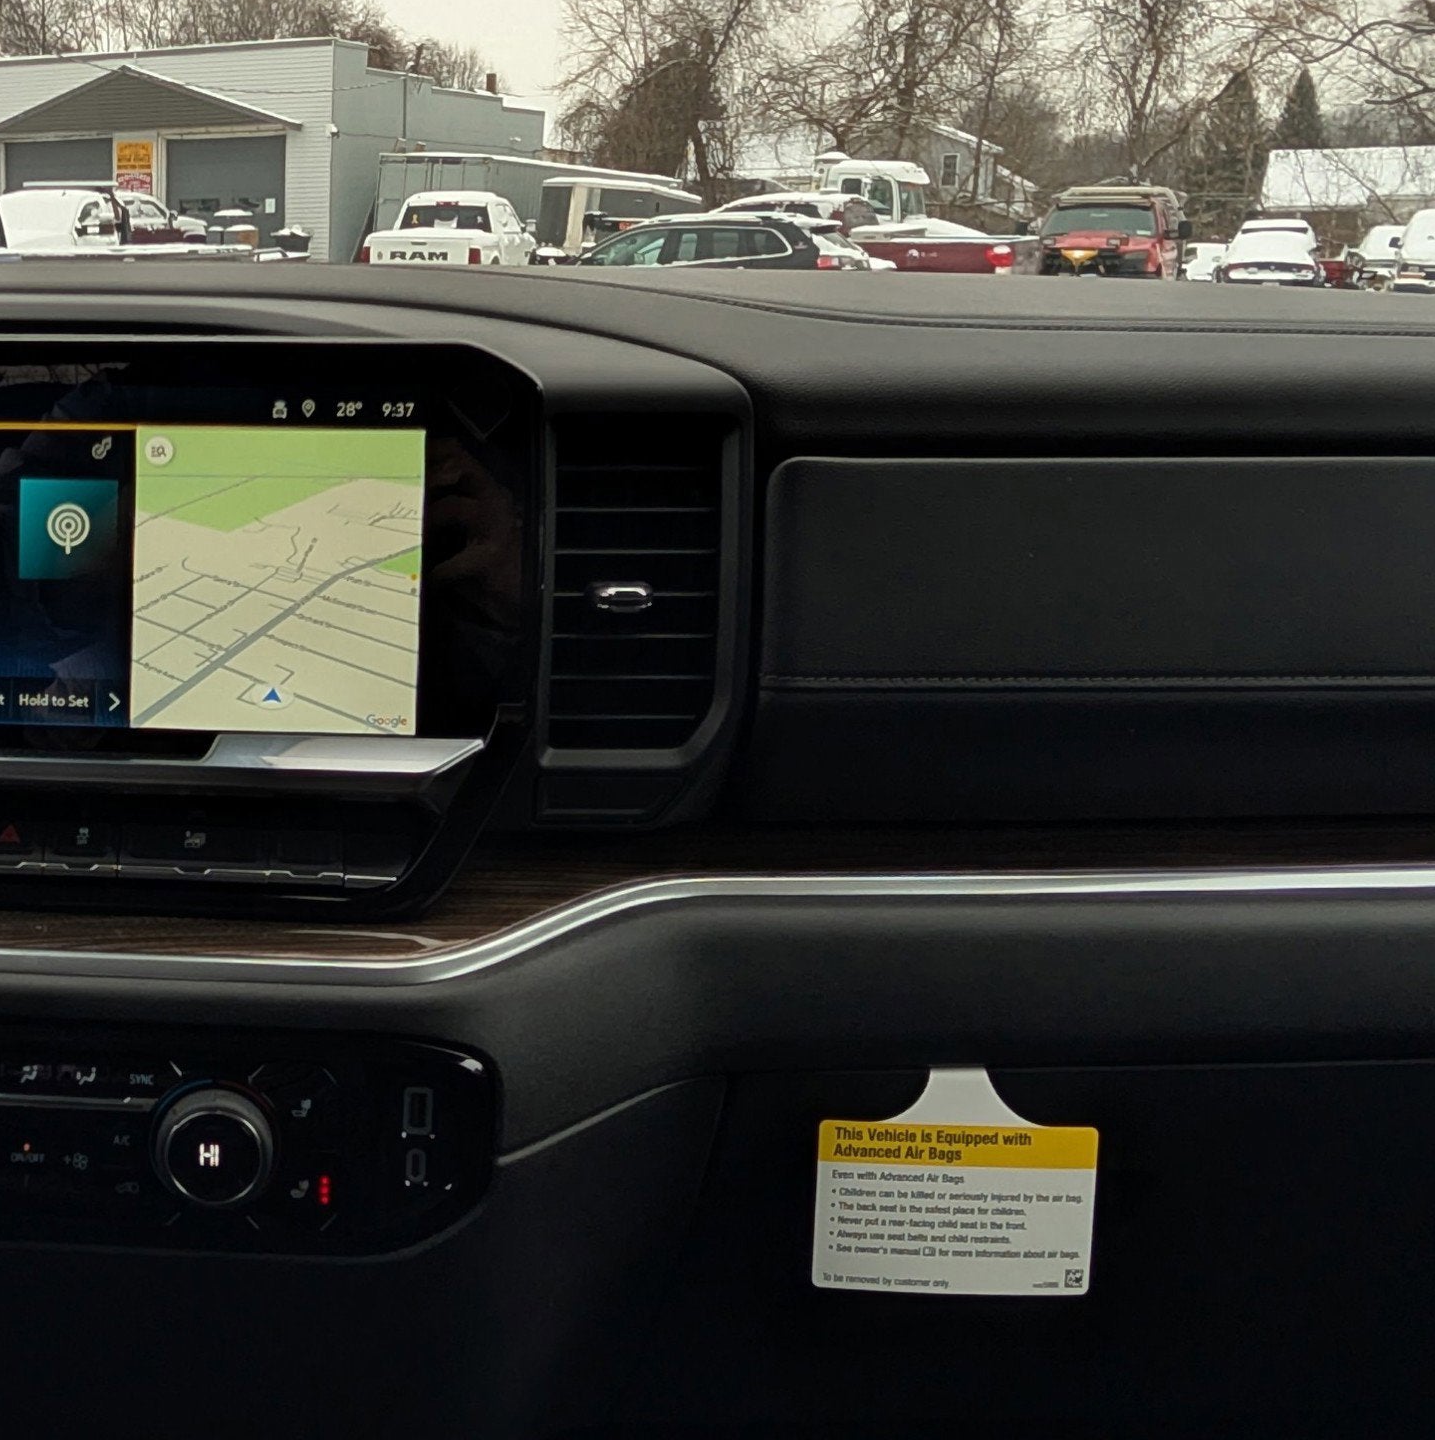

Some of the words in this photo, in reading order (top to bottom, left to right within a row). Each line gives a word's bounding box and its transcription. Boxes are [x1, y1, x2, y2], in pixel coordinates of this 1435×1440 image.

[389, 251, 449, 261] RAM
[381, 402, 416, 418] 9:37
[18, 693, 49, 707] Hold
[51, 694, 66, 707] to
[68, 695, 90, 708] Set
[365, 713, 408, 730] Google
[128, 1073, 154, 1085] SYNC
[835, 1126, 864, 1141] This
[867, 1127, 917, 1143] Vehicle
[936, 1130, 999, 1147] Equipped
[1002, 1132, 1032, 1146] with
[198, 1143, 220, 1168] HI
[833, 1143, 901, 1159] Advanced
[905, 1145, 924, 1159] Air
[928, 1146, 962, 1163] Bags
[831, 1169, 854, 1179] Even
[857, 1170, 877, 1180] with
[879, 1171, 924, 1182] Advanced
[926, 1173, 939, 1182] Air
[942, 1173, 964, 1185] Bags
[838, 1187, 877, 1197] Children
[878, 1190, 895, 1198] can
[897, 1190, 908, 1198] be
[910, 1190, 935, 1199] killed
[949, 1192, 988, 1203] seriously
[990, 1192, 1021, 1203] injured
[1023, 1193, 1034, 1204] by
[1035, 1193, 1050, 1202] the
[838, 1201, 854, 1210] The
[856, 1202, 877, 1211] back
[909, 1205, 923, 1213] the
[977, 1206, 989, 1215] for
[837, 1215, 863, 1225] Never
[937, 1219, 958, 1229] child
[989, 1221, 1003, 1230] the
[836, 1229, 868, 1240] Always
[948, 1234, 969, 1243] child
[836, 1243, 852, 1252] See
[938, 1248, 950, 1256] for
[951, 1249, 973, 1257] more
[975, 1249, 1021, 1258] information
[822, 1272, 832, 1282] To
[833, 1273, 844, 1282] be
[845, 1274, 880, 1284] removed
[882, 1276, 892, 1287] by
[894, 1278, 931, 1287] customer
